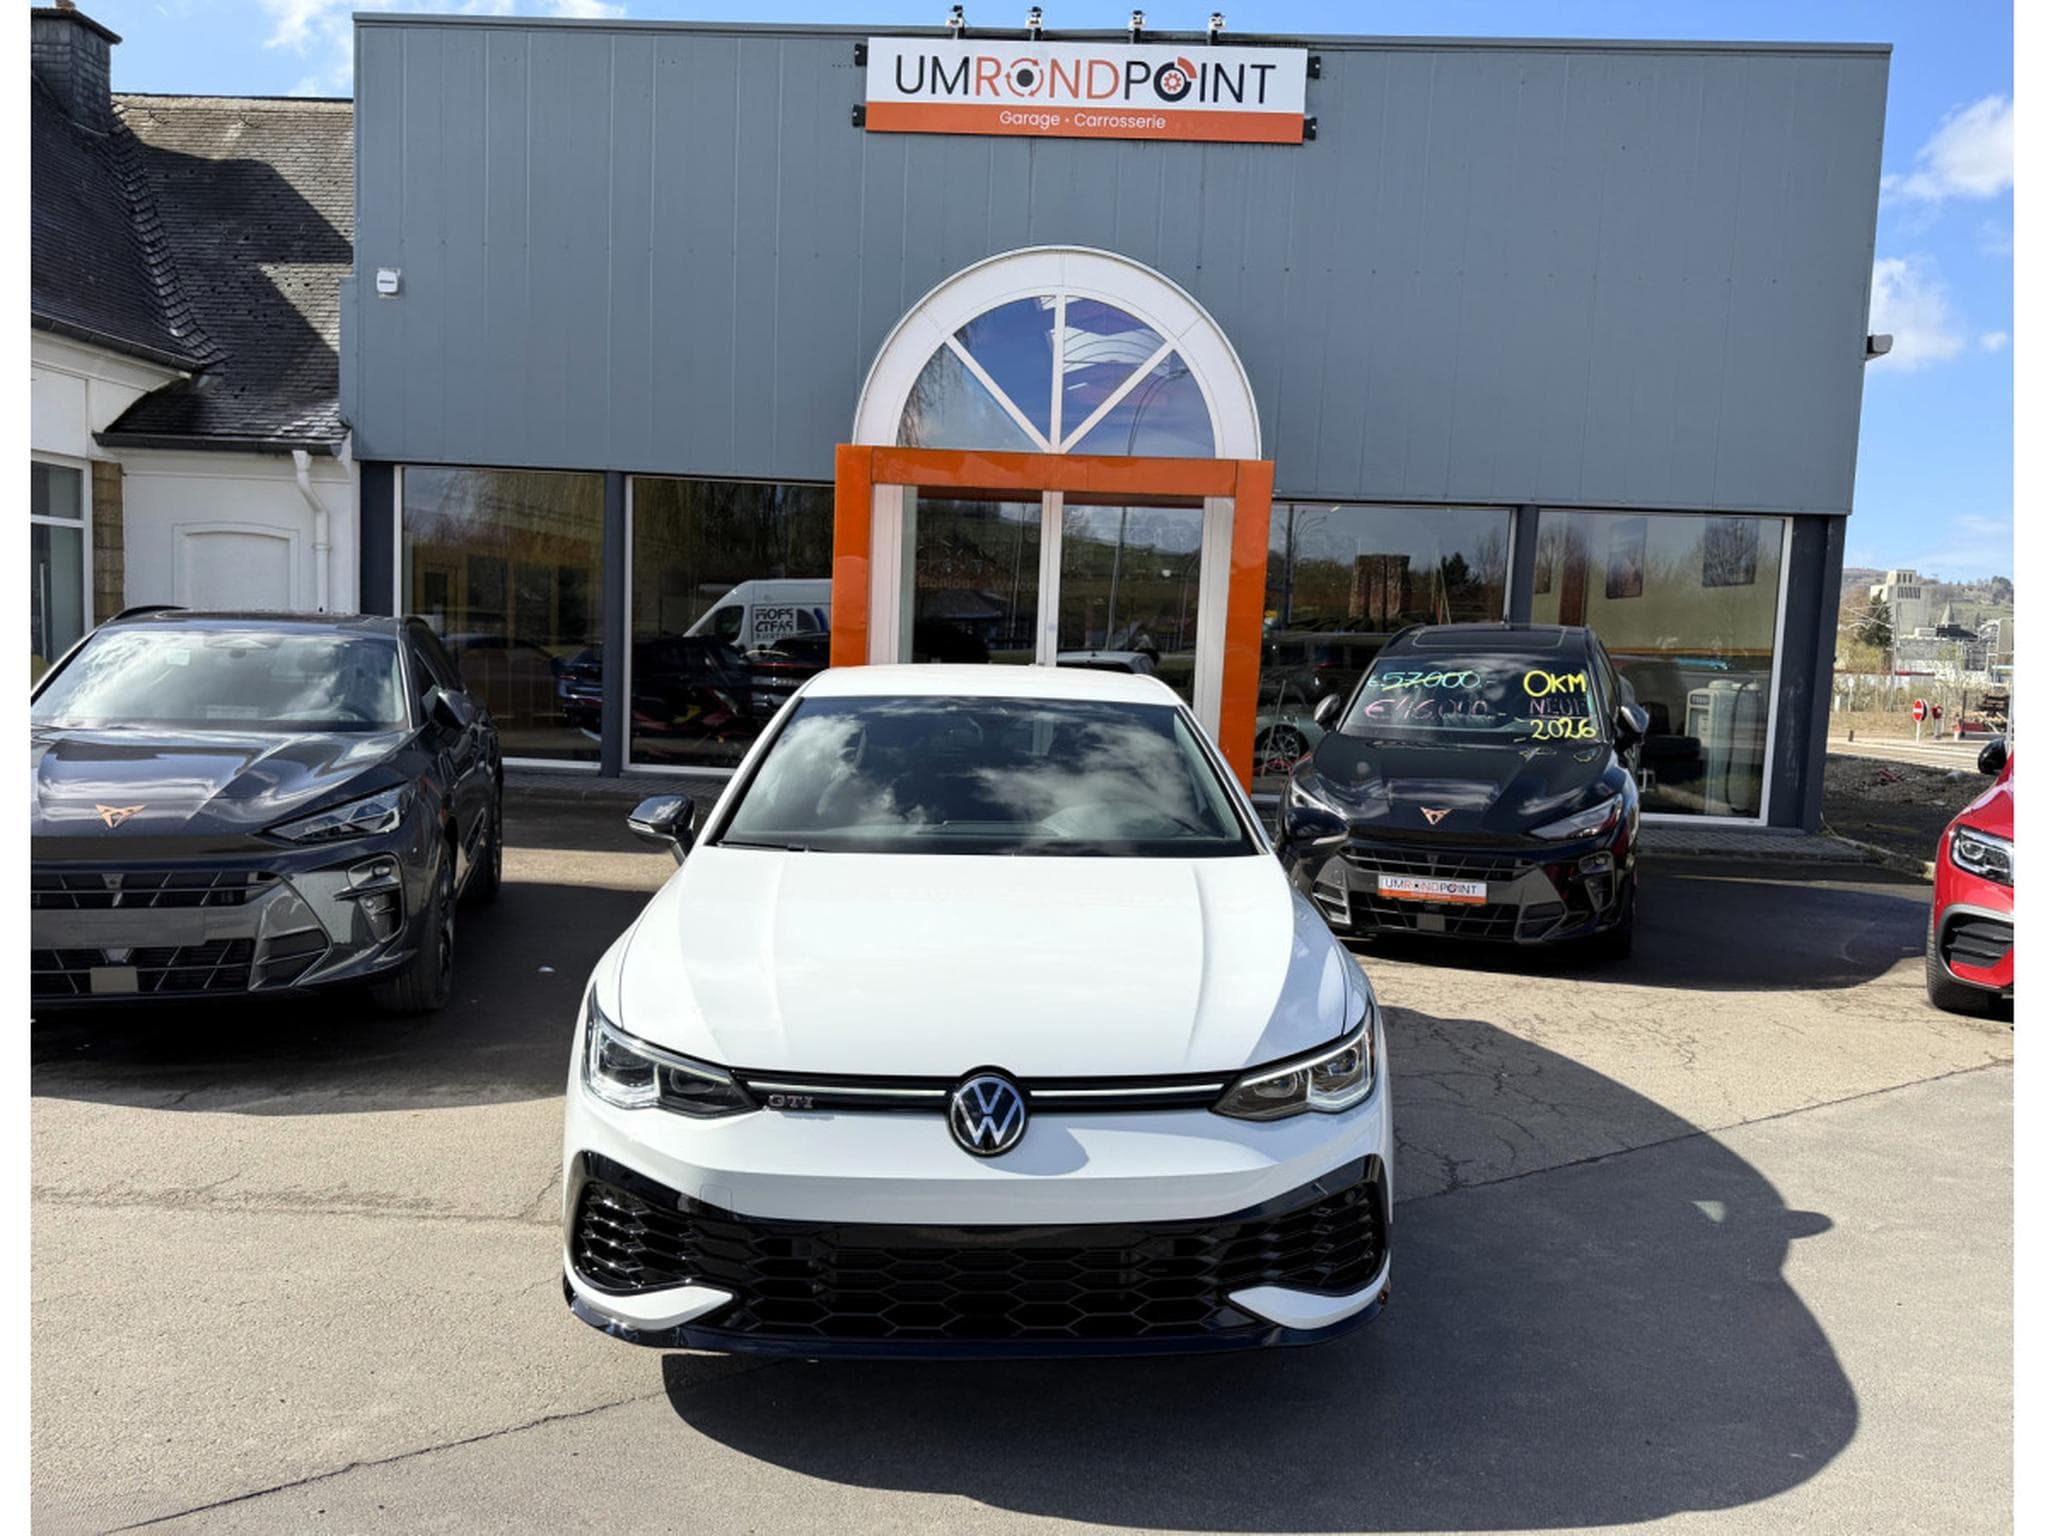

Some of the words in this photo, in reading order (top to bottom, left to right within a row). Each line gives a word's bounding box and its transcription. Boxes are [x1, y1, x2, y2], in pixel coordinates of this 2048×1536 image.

[999, 110, 1061, 129] Garage
[1074, 113, 1166, 129] Carrosserie
[1530, 718, 1597, 740] 2026
[768, 1094, 813, 1109] GTI
